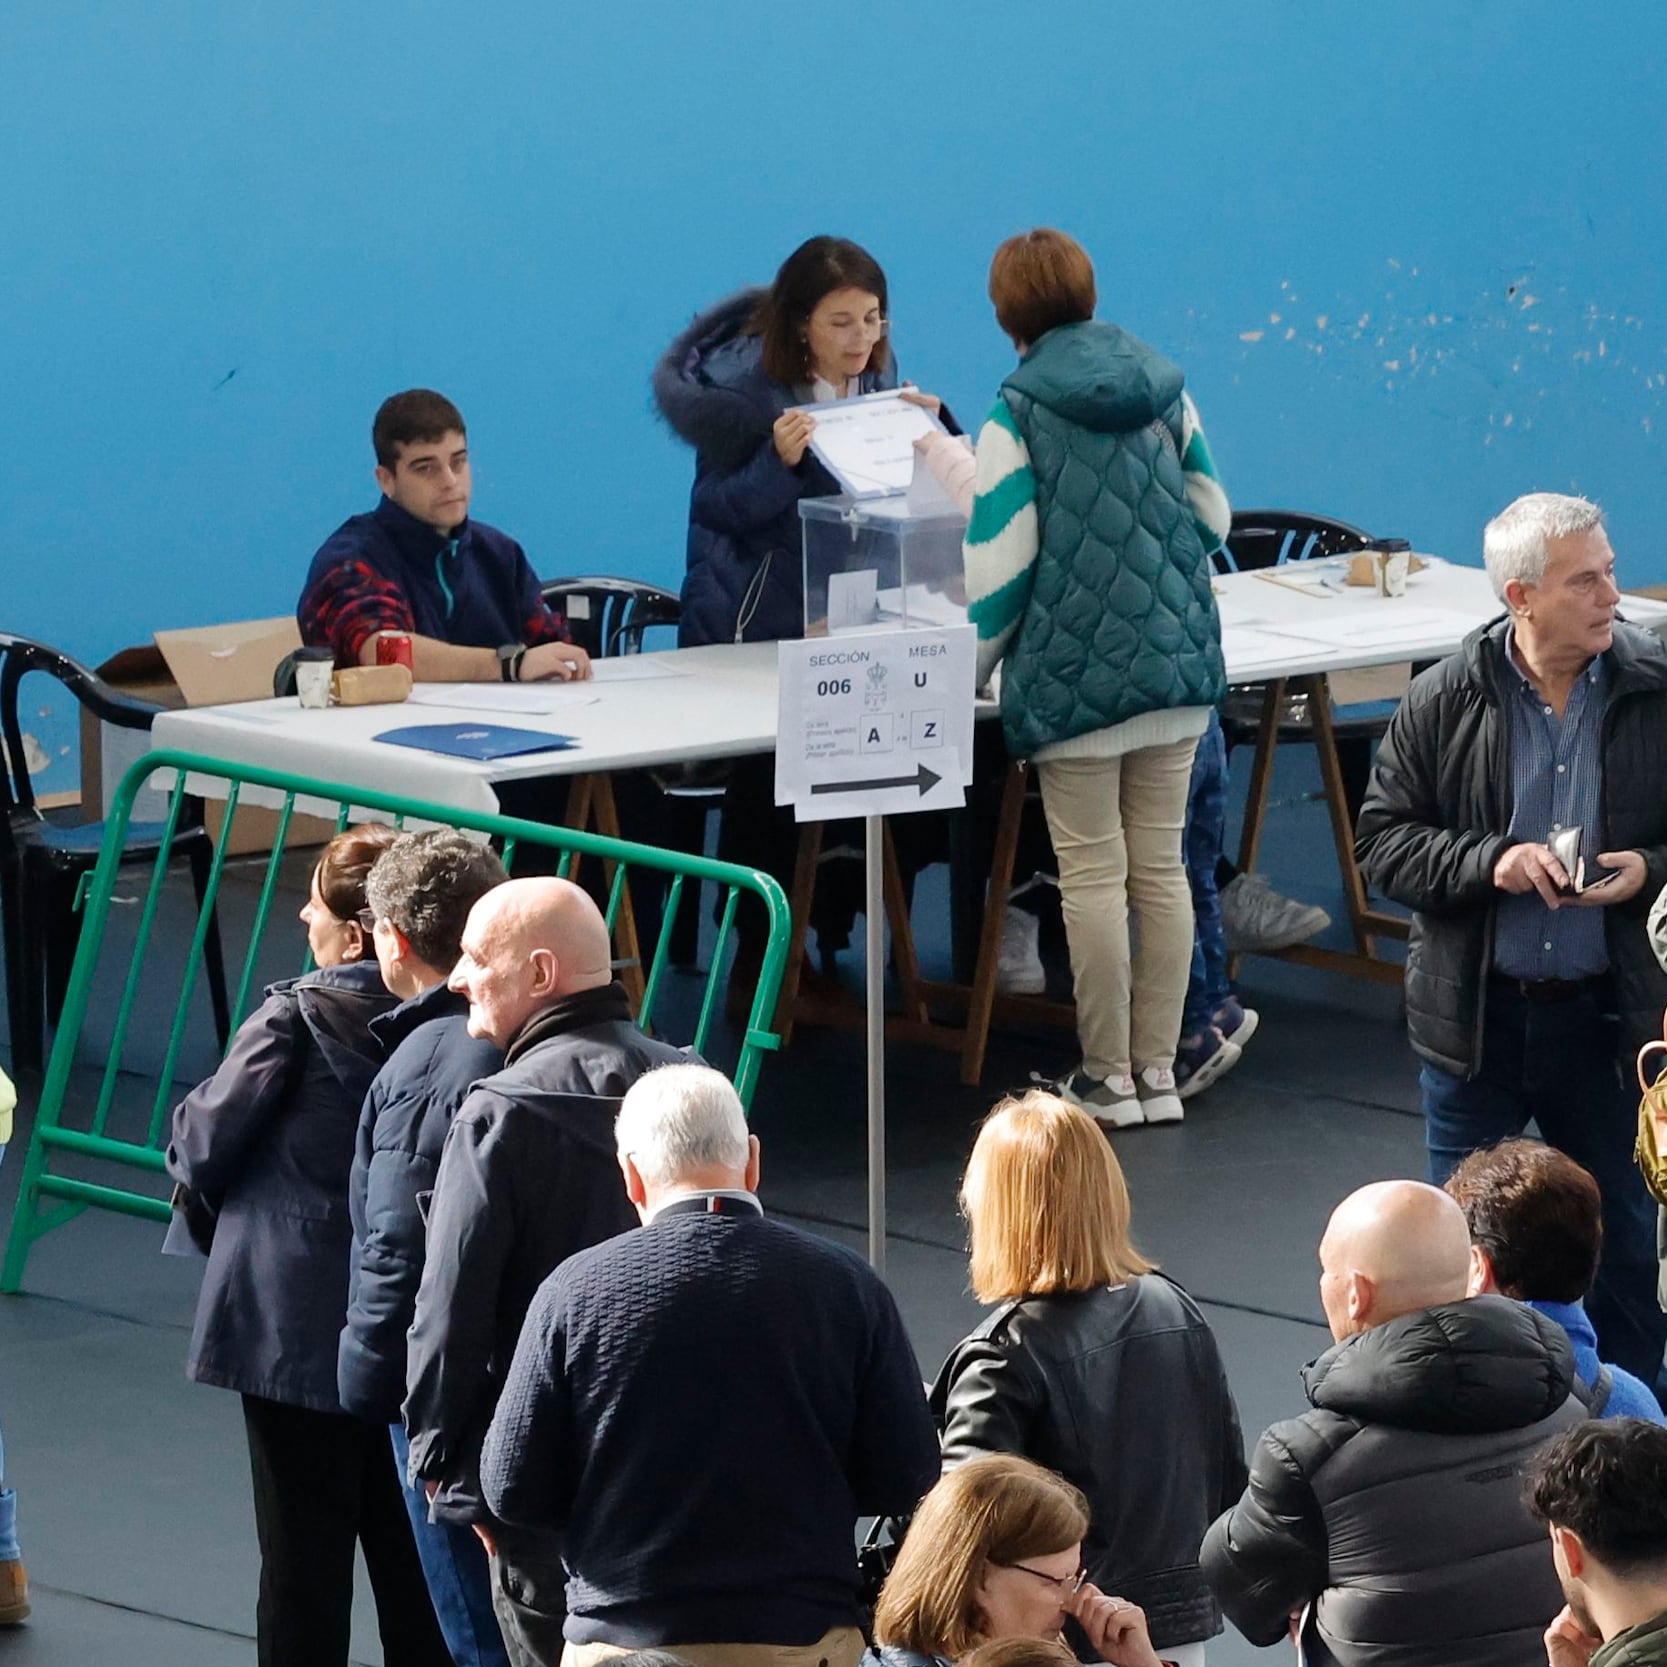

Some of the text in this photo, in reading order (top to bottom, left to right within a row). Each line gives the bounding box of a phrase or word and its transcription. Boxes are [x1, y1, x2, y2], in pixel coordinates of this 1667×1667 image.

[809, 651, 871, 667] SECCIÓN
[908, 645, 947, 658] MESA
[817, 678, 852, 696] 006
[914, 672, 927, 688] U
[867, 727, 881, 743] A
[924, 722, 936, 738] Z
